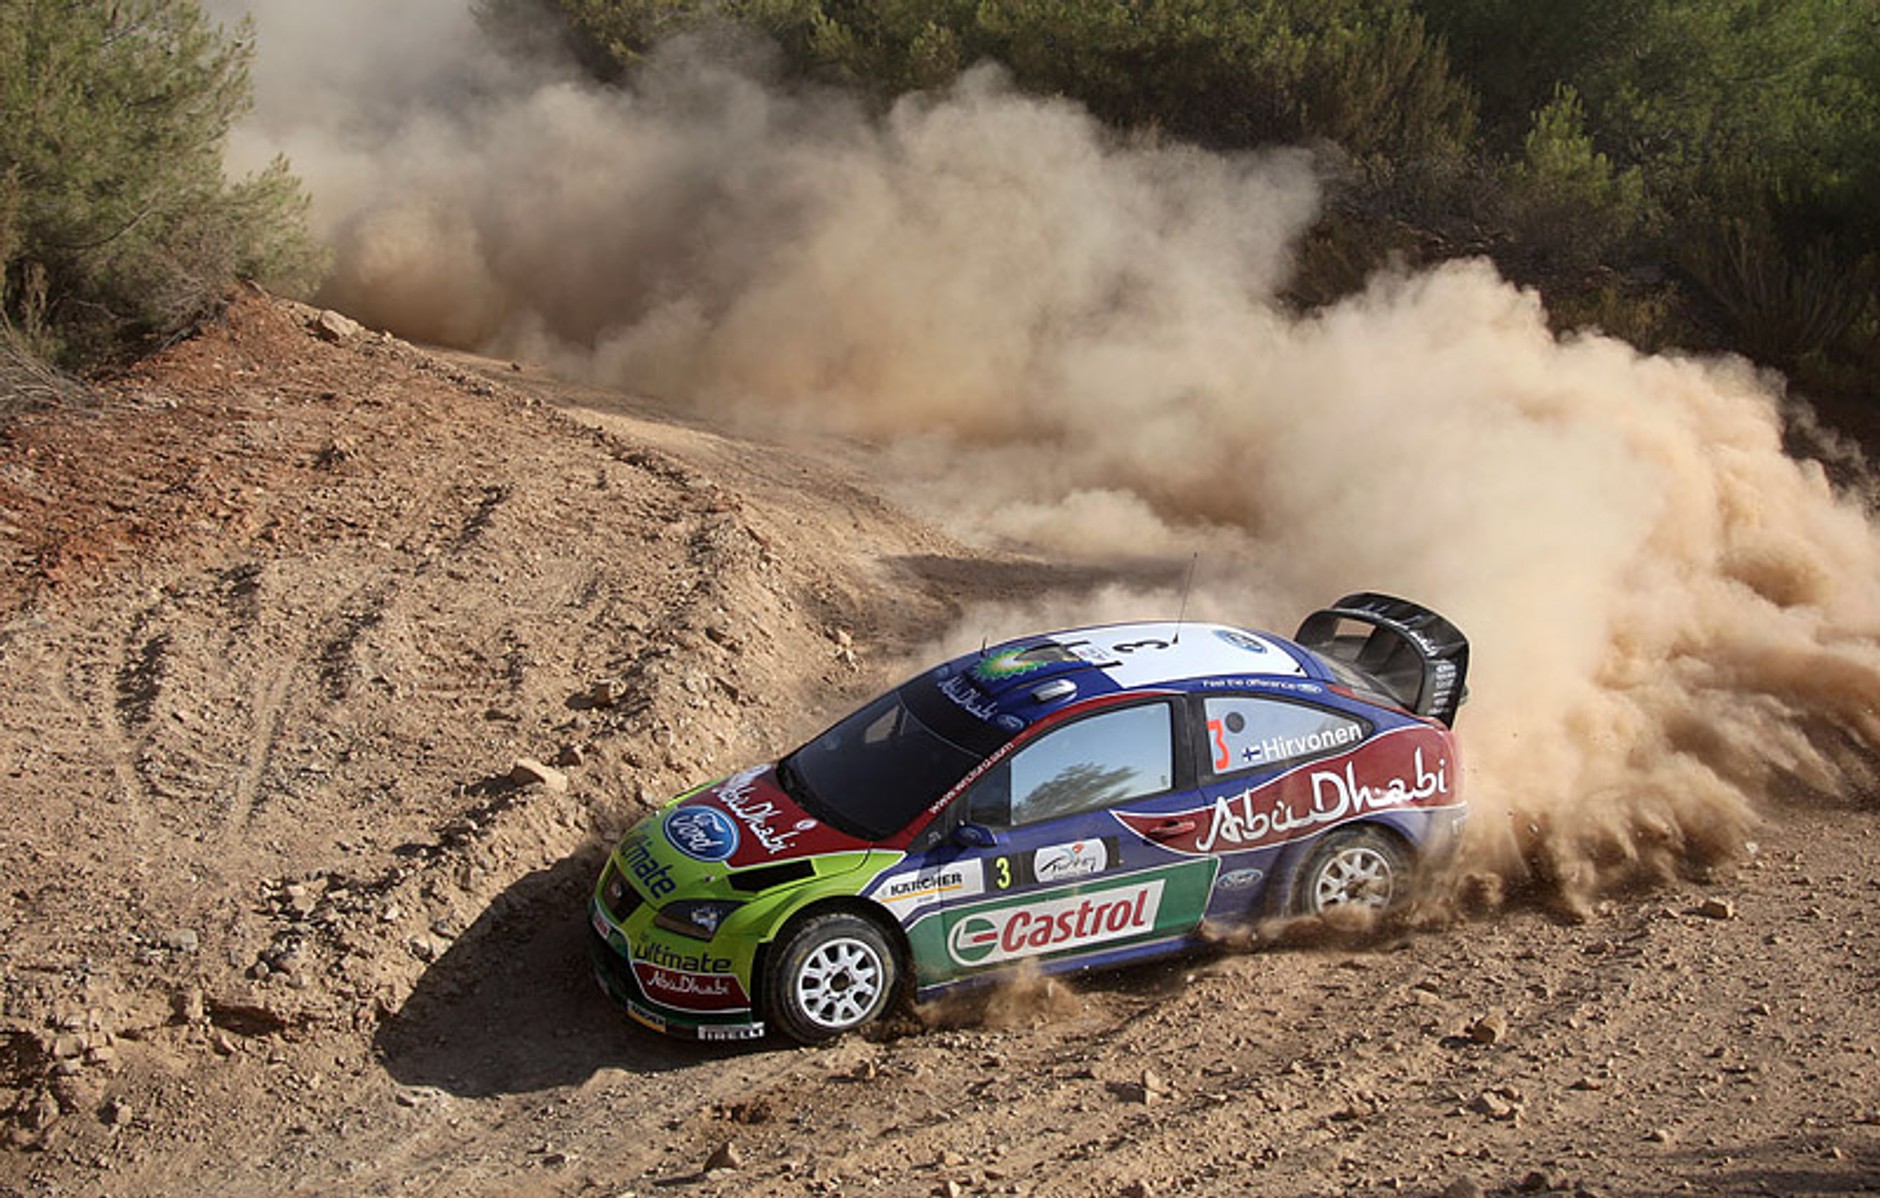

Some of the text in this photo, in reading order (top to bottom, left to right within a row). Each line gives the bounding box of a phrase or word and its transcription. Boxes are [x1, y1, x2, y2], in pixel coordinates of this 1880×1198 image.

[1207, 719, 1363, 771] 3 Hirvonen
[1196, 747, 1448, 851] Abu Dhabi
[669, 811, 726, 852] Ford
[995, 857, 1012, 889] 3
[1001, 888, 1149, 952] Castrol
[633, 941, 733, 973] ultimate
[646, 970, 729, 996] Abu Dhabi
